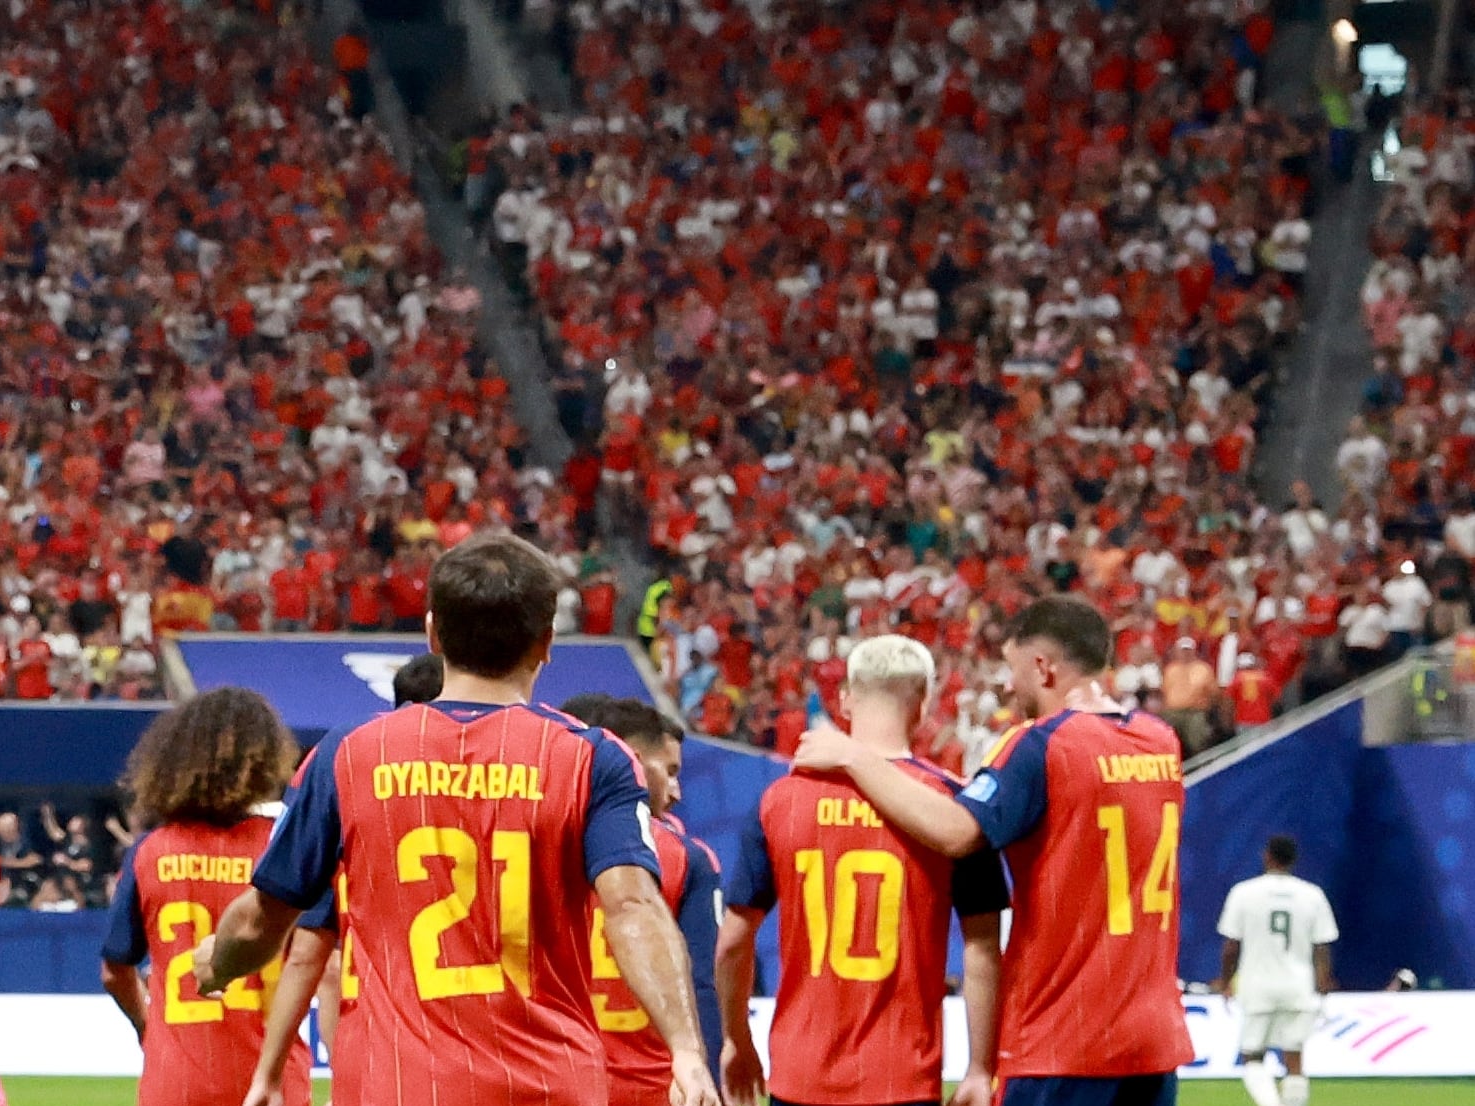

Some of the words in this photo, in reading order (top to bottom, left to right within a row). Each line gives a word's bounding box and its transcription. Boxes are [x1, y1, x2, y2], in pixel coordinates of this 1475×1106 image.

[373, 761, 544, 800] OYARZABAL
[397, 826, 531, 1001] 21
[795, 849, 904, 981] 10
[1097, 802, 1180, 936] 14
[1270, 910, 1291, 951] 9
